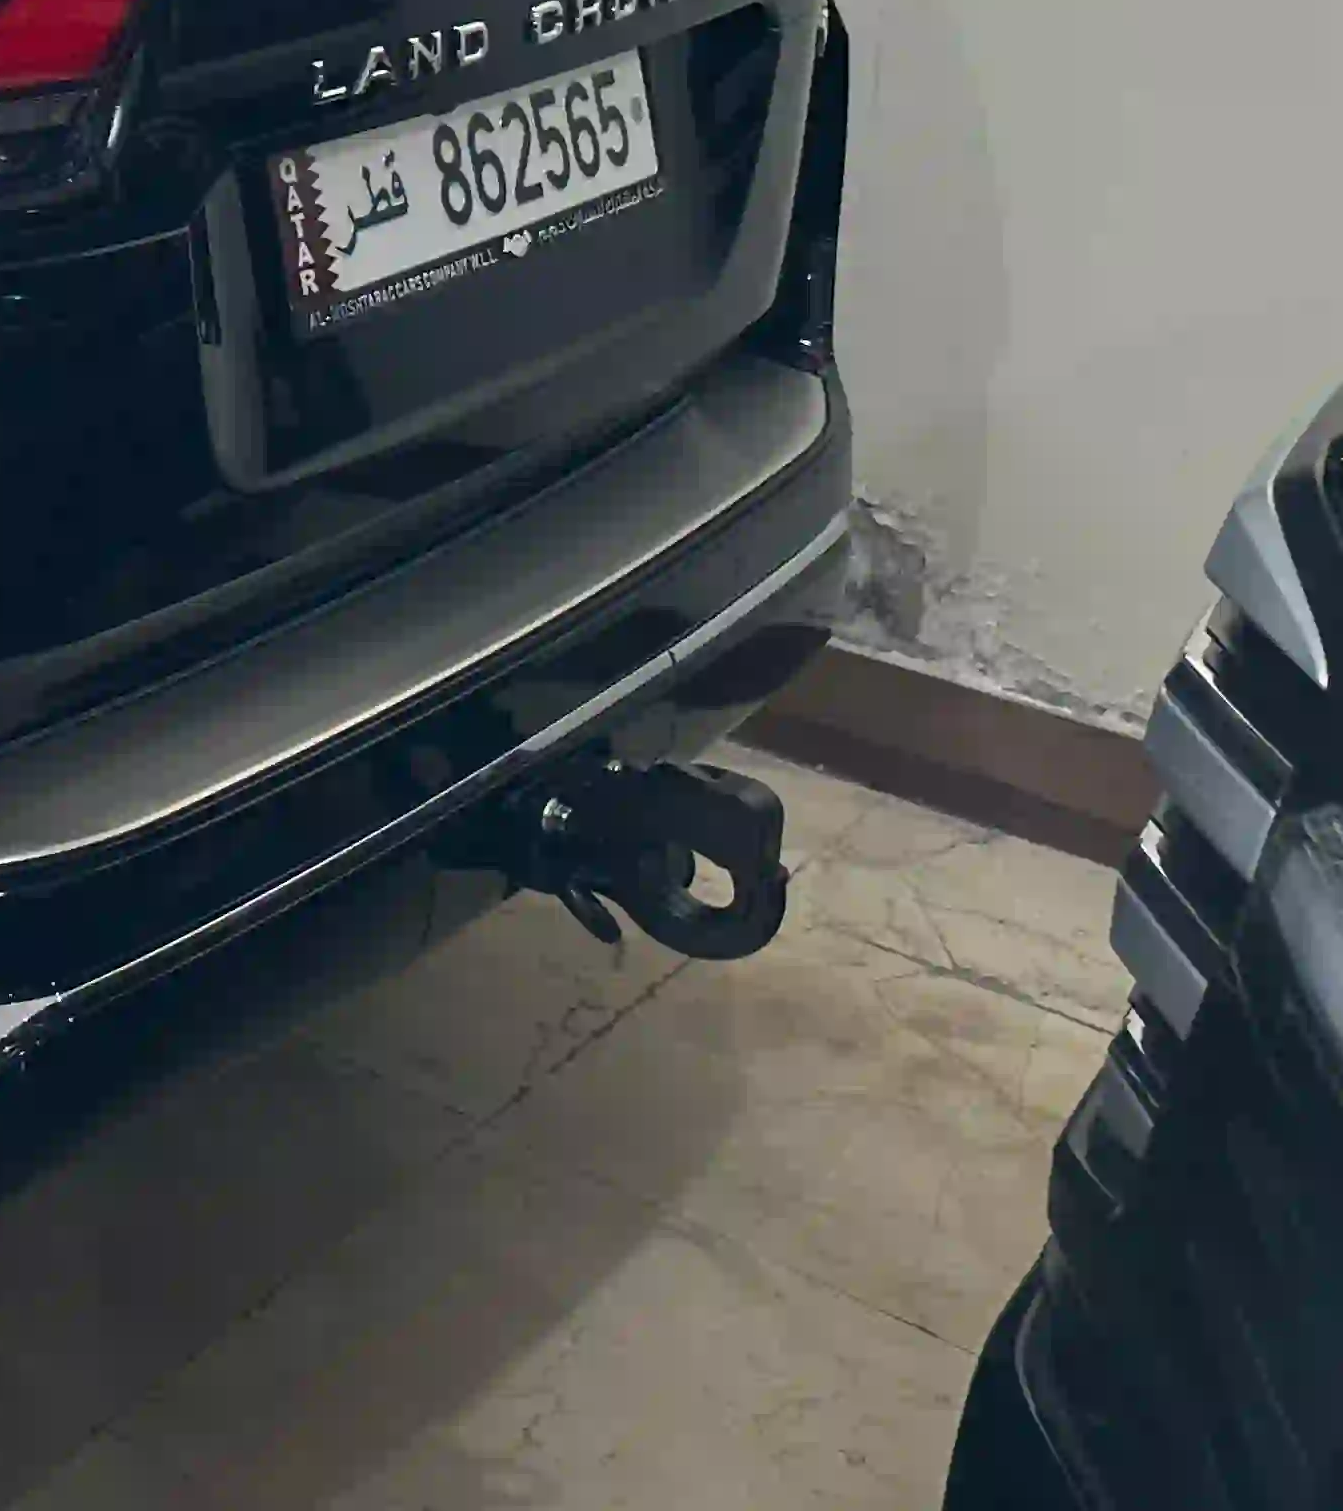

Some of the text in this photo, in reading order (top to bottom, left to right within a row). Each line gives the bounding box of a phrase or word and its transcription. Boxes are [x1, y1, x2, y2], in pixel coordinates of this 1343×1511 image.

[312, 21, 489, 101] LAND
[336, 150, 409, 257] قطر
[433, 70, 631, 227] 862565
[279, 157, 320, 297] QATAR
